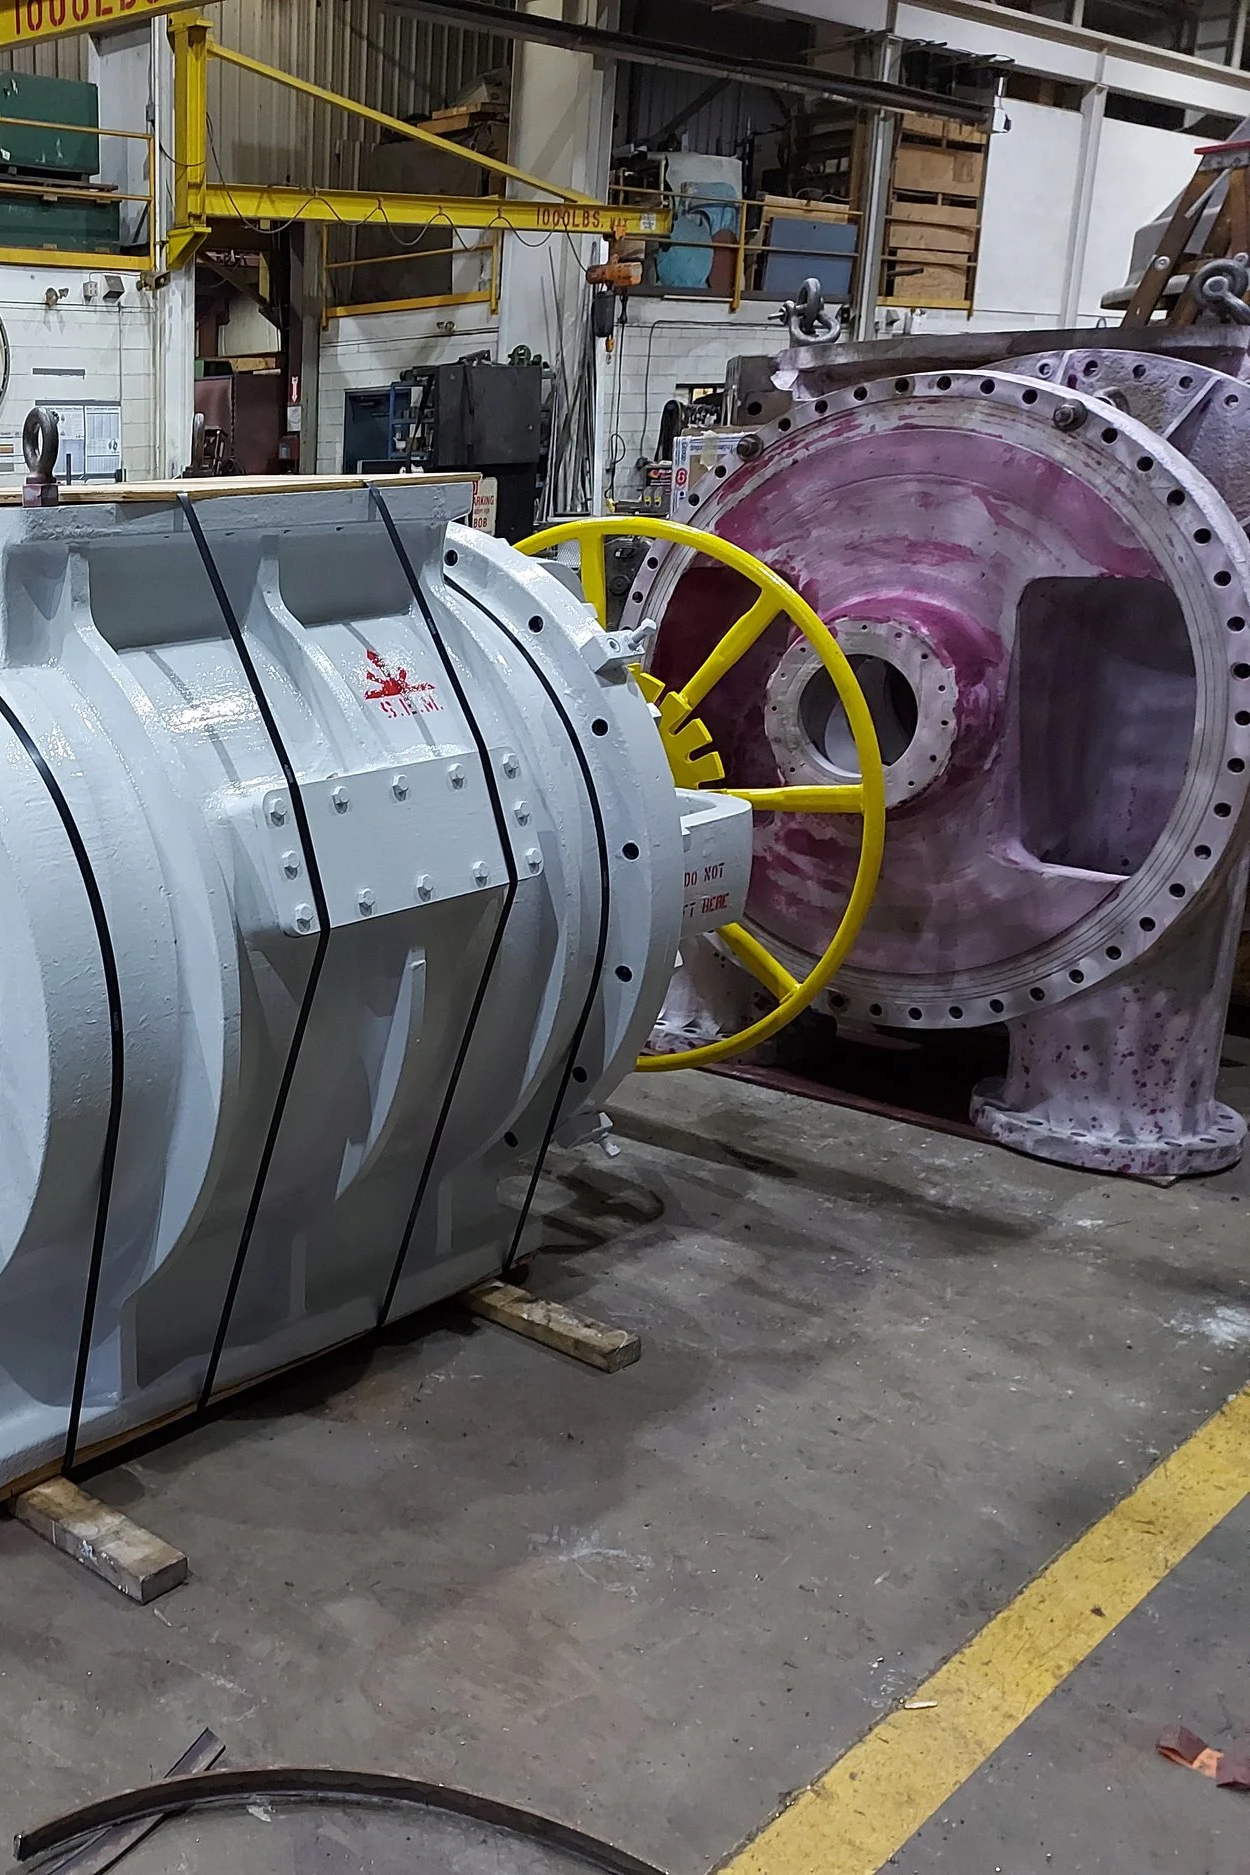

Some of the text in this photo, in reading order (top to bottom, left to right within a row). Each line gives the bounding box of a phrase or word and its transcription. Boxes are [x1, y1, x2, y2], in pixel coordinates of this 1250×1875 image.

[15, 0, 159, 35] 1000L
[473, 517, 488, 529] BOB
[683, 862, 726, 888] DO NOT
[683, 892, 730, 918] FT HERE
